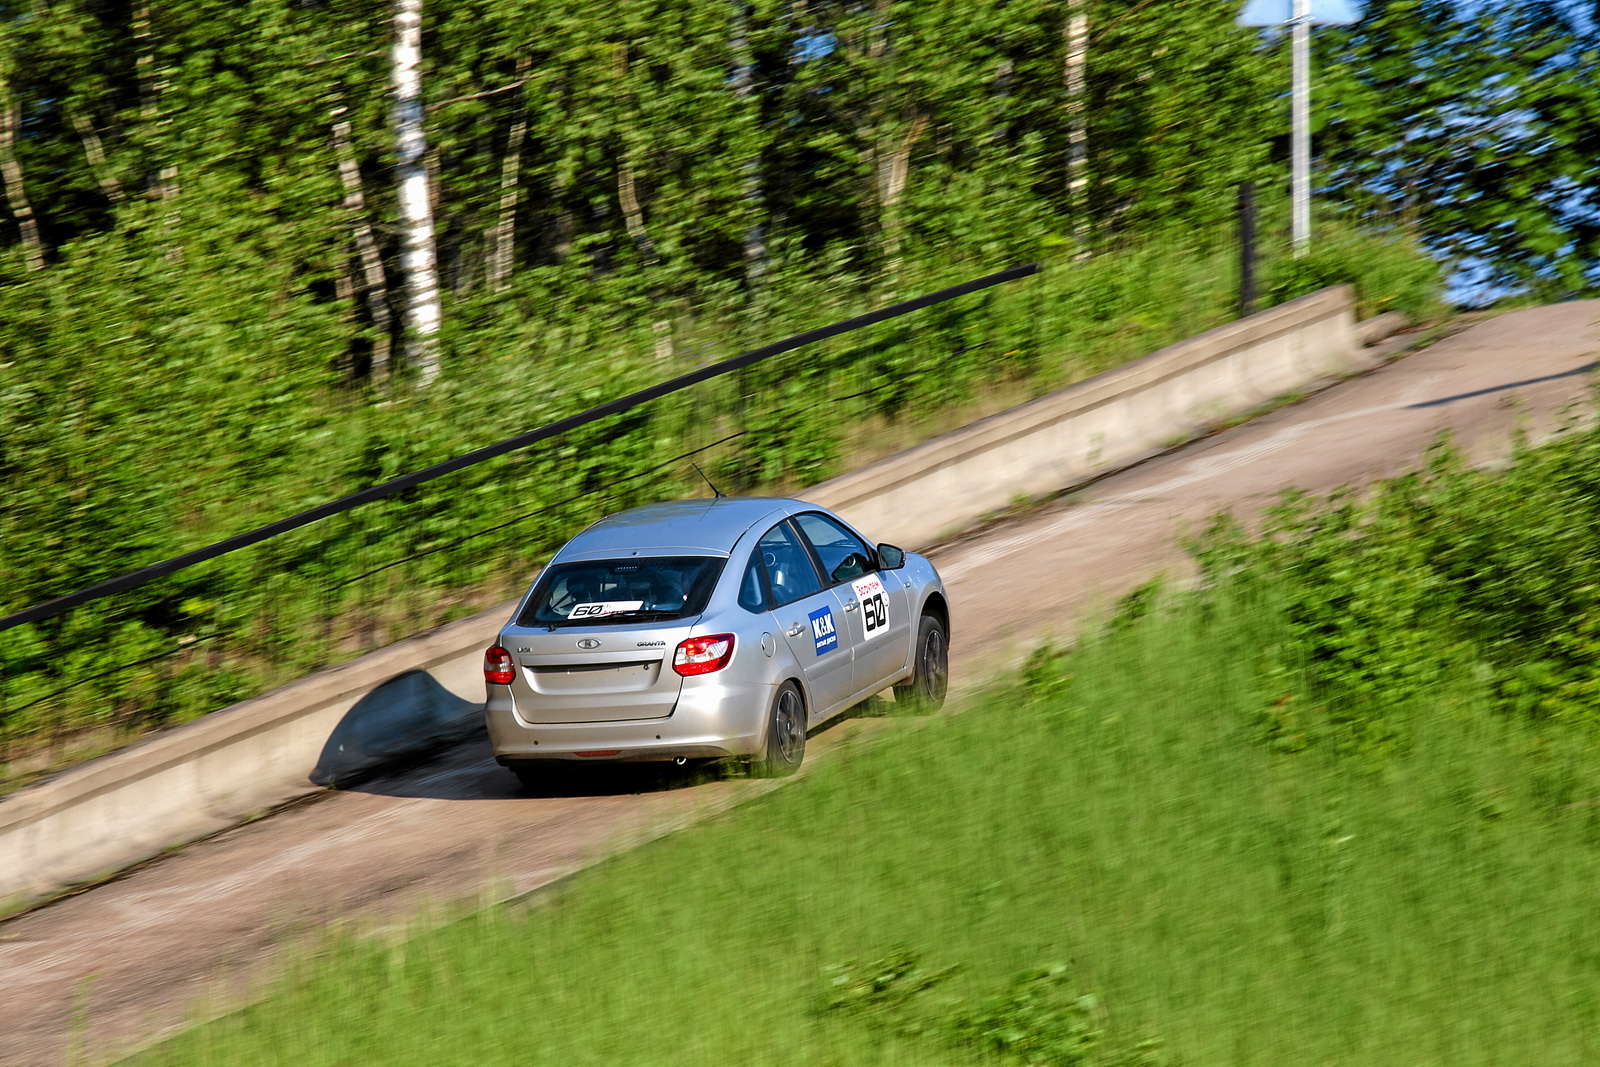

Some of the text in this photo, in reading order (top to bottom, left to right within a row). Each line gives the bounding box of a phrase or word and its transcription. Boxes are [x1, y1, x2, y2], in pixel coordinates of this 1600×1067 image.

[573, 605, 604, 616] 60
[863, 593, 886, 632] 60
[812, 614, 835, 639] K&K
